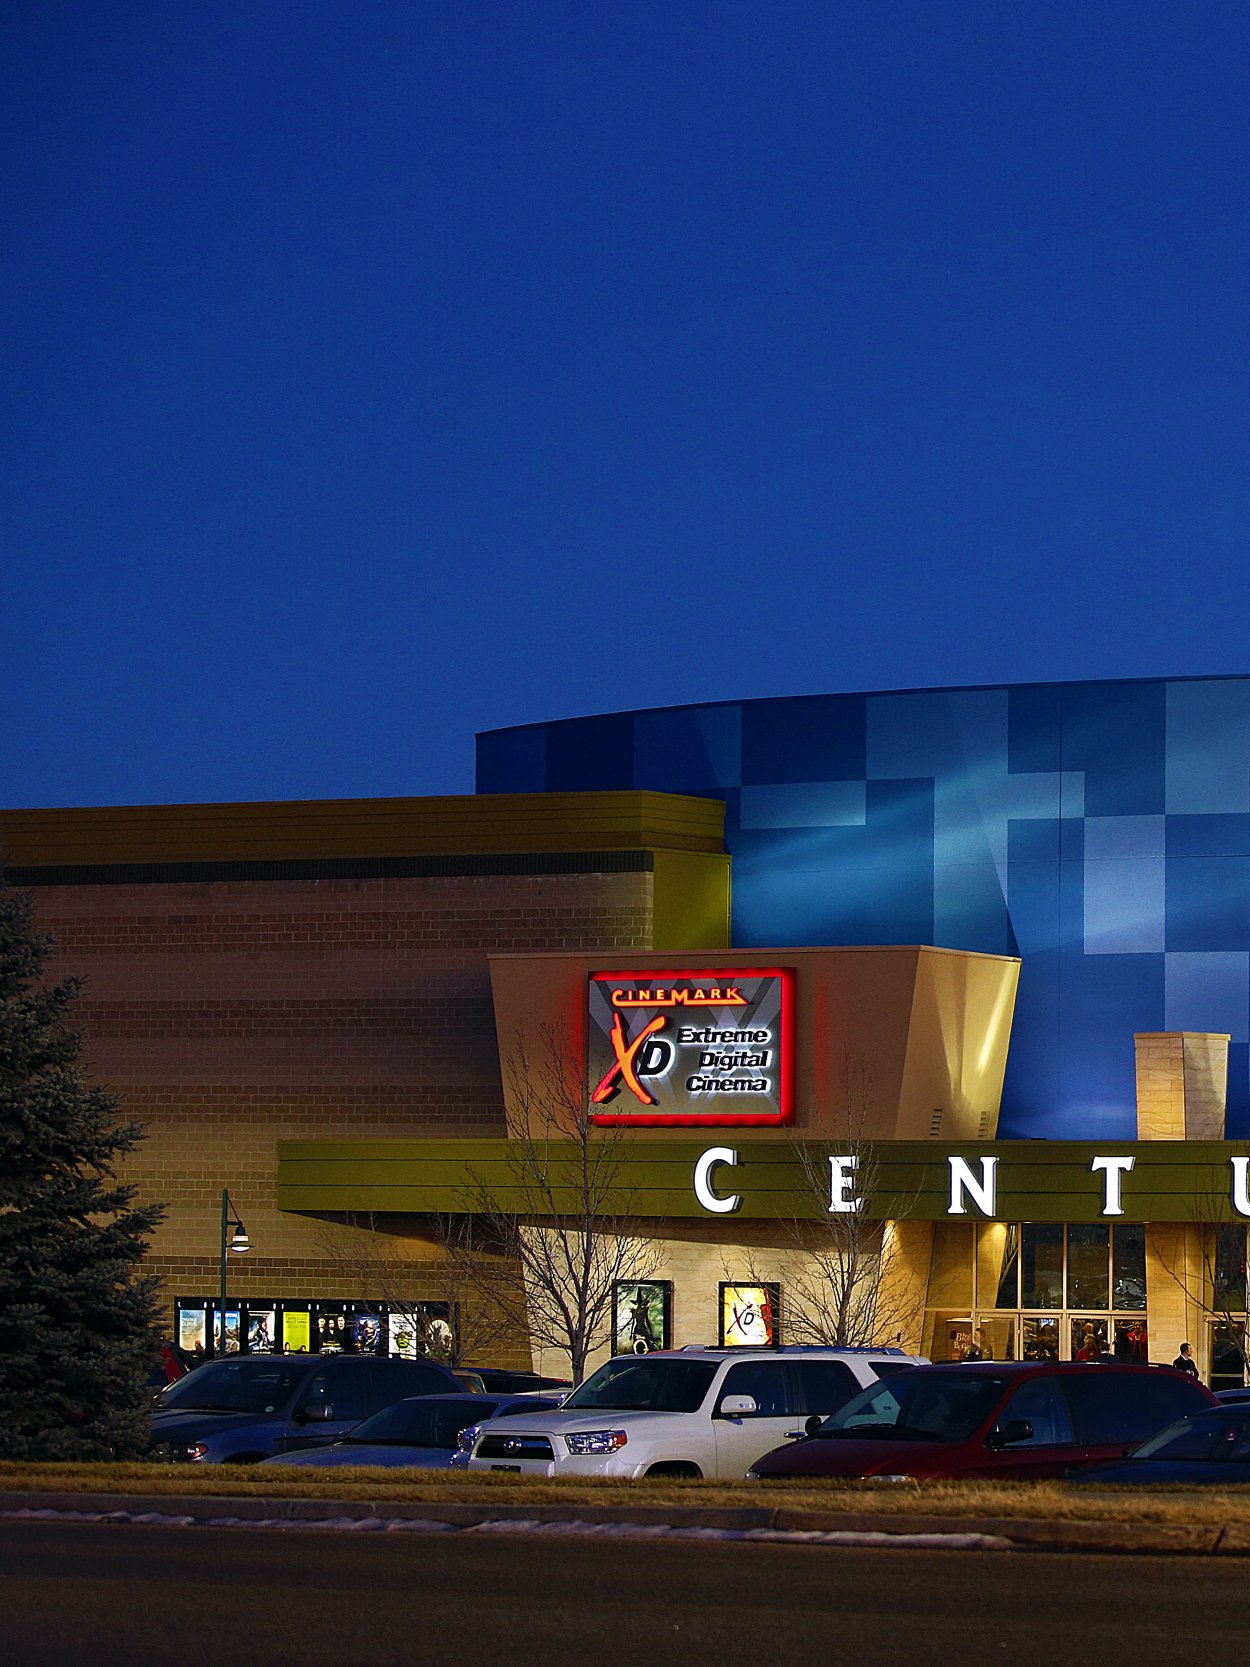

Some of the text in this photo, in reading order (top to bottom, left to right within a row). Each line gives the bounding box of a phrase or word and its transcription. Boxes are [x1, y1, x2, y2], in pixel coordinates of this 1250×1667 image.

[611, 987, 750, 1007] CINEMARK
[677, 1027, 768, 1044] Extreme
[592, 1012, 675, 1105] XD
[699, 1050, 769, 1071] Digital
[686, 1075, 768, 1092] Cinema
